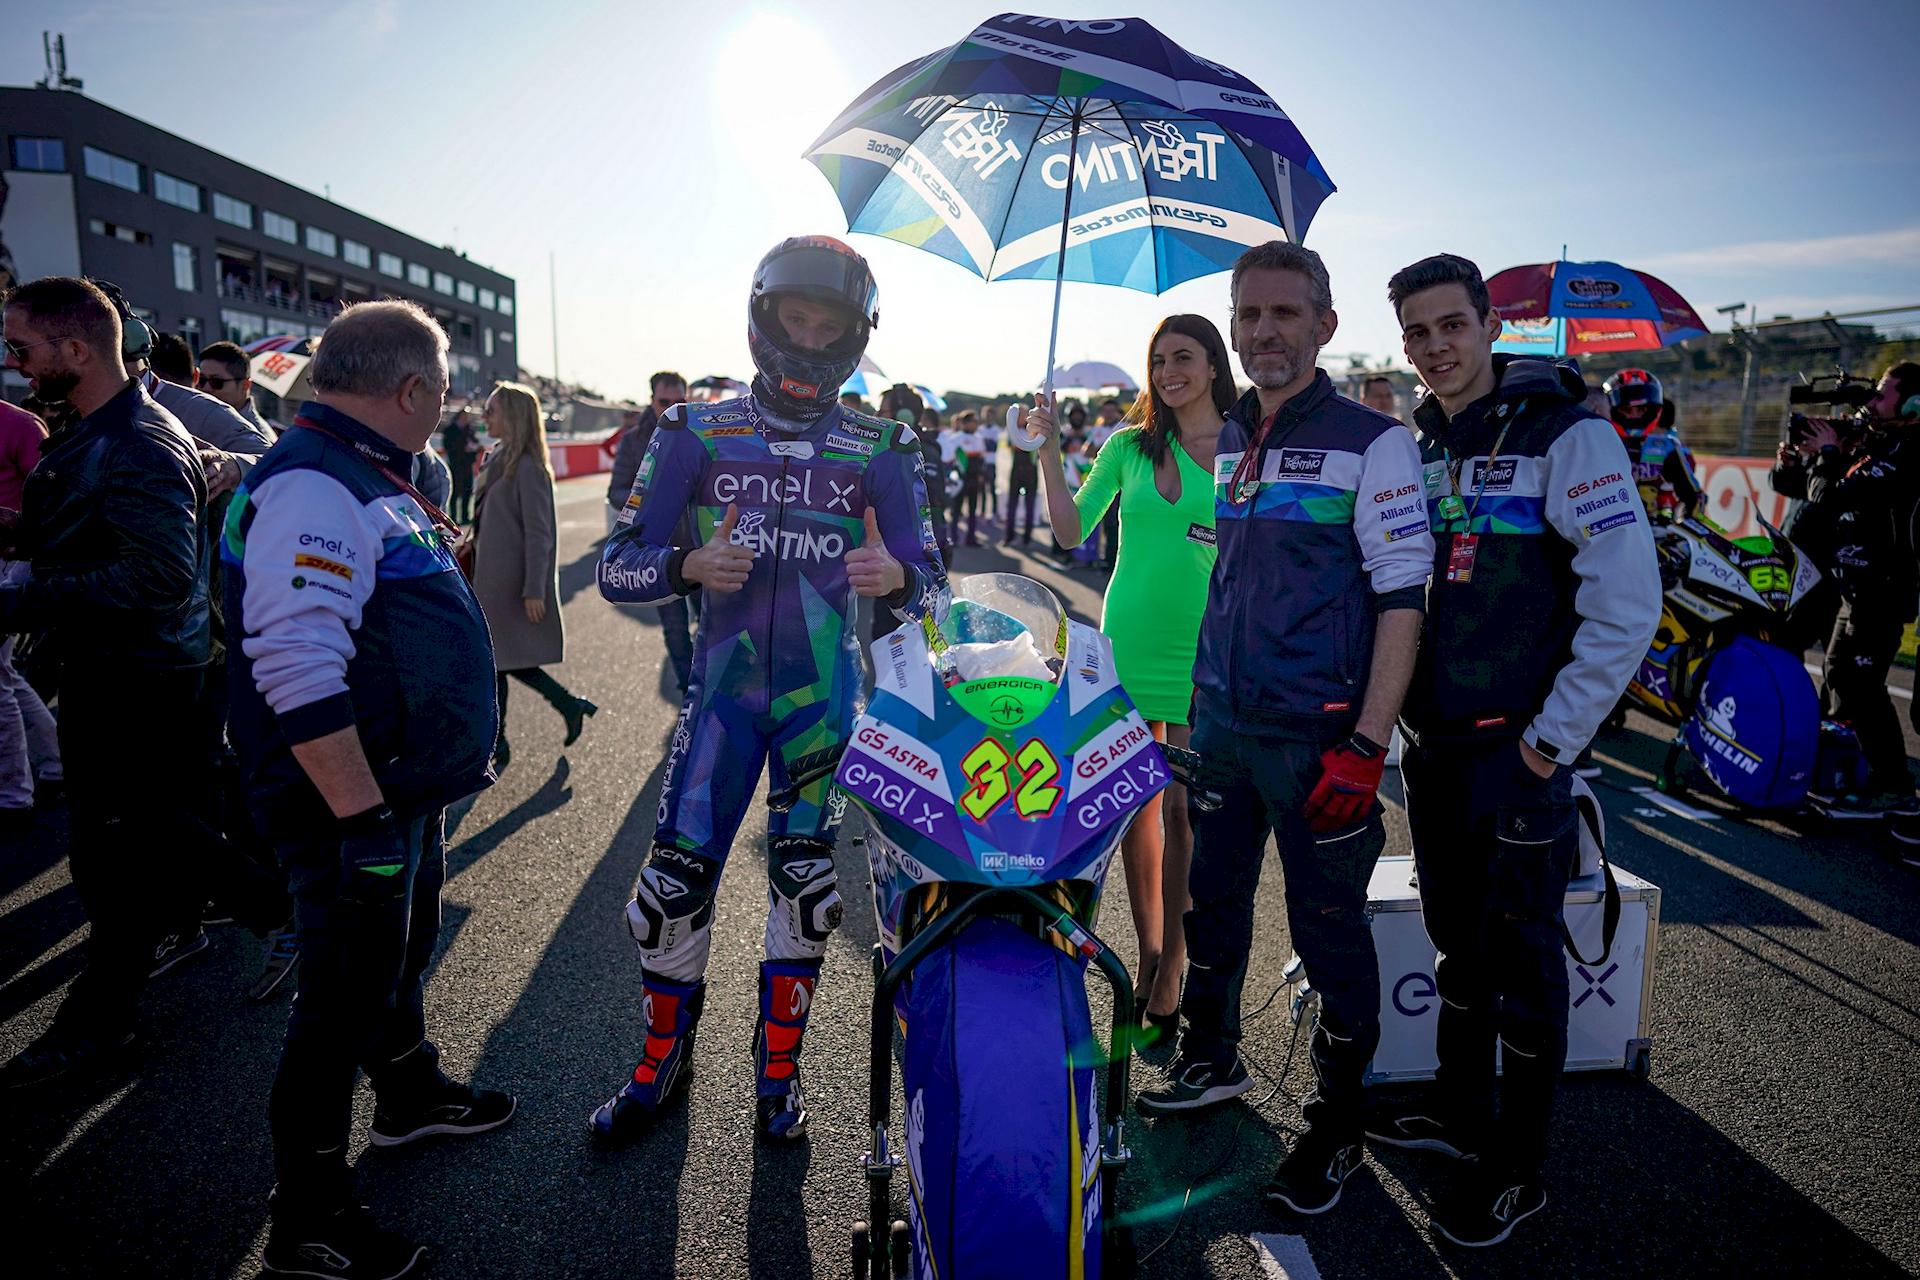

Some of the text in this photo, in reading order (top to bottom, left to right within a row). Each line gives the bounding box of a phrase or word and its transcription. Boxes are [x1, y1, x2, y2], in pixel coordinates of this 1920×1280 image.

[710, 426, 747, 437] DHL
[827, 435, 859, 450] Allianz
[841, 419, 880, 439] TRENTINO
[1283, 457, 1321, 472] TRENTINO
[713, 469, 813, 507] enel
[1373, 490, 1395, 504] GS
[1567, 472, 1624, 499] GS ASTRA
[1380, 505, 1416, 522] Allianz
[1575, 495, 1618, 518] Allianz
[299, 533, 343, 557] enel
[712, 520, 844, 565] RENTINO
[304, 556, 348, 576] DHL
[601, 561, 658, 592] TRENTINO
[1694, 556, 1734, 583] enel
[1749, 564, 1791, 593] 63
[857, 727, 939, 782] GS ASTRA
[1076, 725, 1148, 779] GS ASTRA
[1699, 725, 1760, 776] CHELIN
[844, 763, 918, 817] enel
[960, 736, 1065, 826] 32
[1077, 768, 1144, 830] enel
[1008, 853, 1046, 867] neiko
